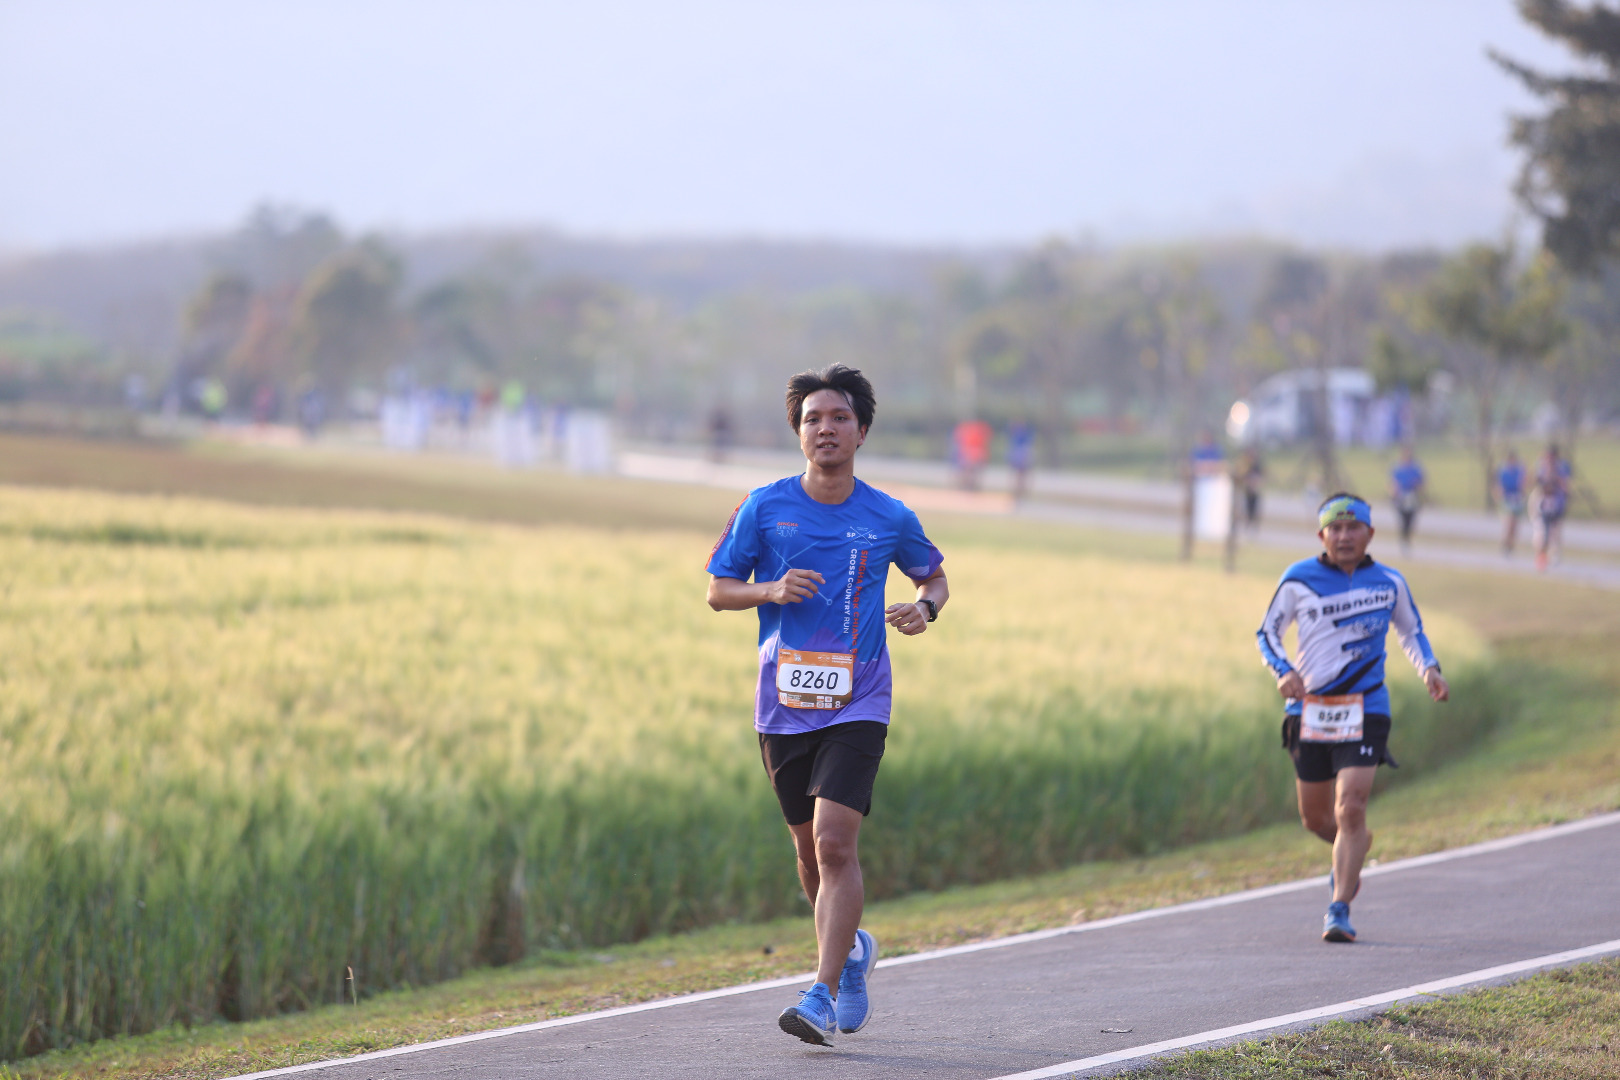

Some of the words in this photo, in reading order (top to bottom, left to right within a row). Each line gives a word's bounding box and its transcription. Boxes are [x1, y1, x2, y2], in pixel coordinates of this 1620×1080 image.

[848, 548, 857, 576] CROSS
[856, 549, 868, 584] SINGHA
[844, 577, 854, 616] COUNTRY
[853, 586, 862, 609] PARK
[1322, 594, 1389, 616] Bianchi
[852, 611, 860, 646] CHIANG
[790, 669, 839, 690] 8260
